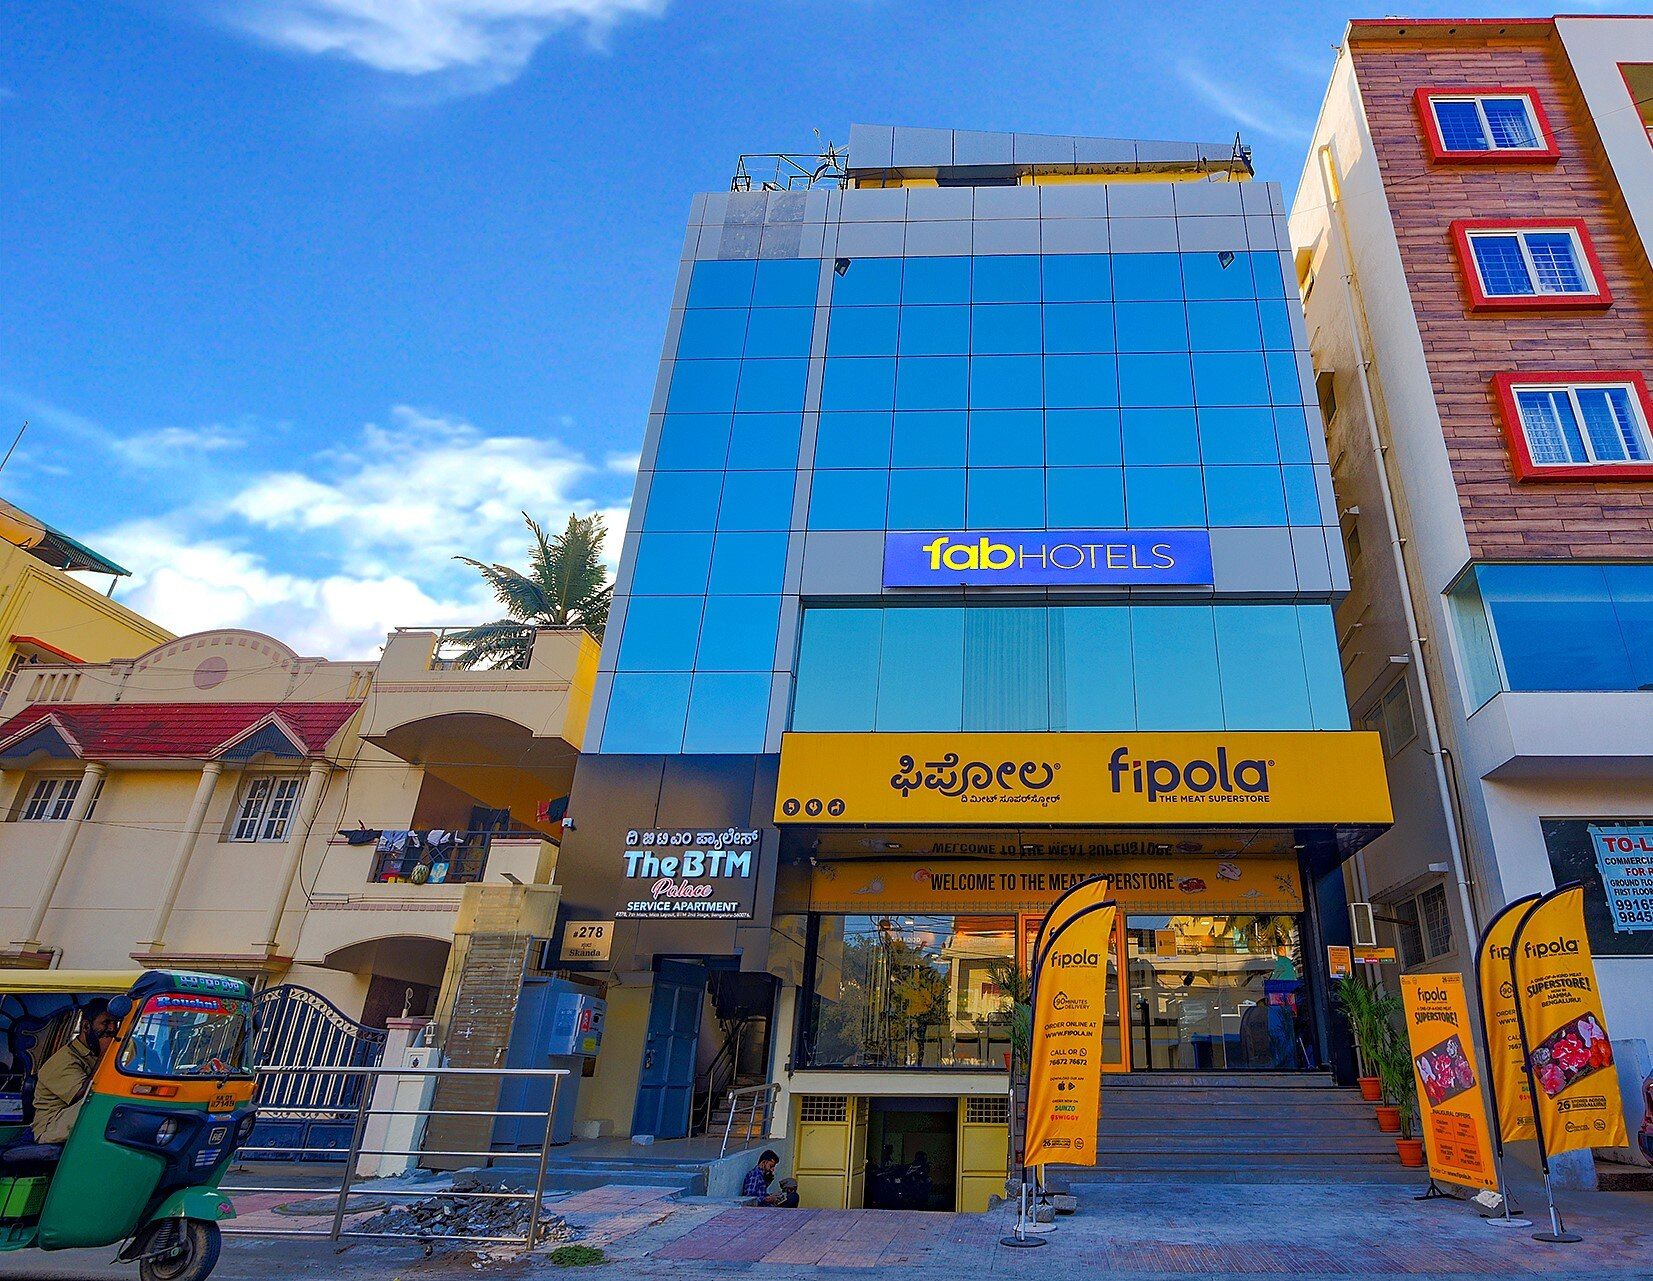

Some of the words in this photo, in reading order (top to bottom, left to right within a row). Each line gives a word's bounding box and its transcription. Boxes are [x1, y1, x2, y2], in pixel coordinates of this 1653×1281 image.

[1108, 746, 1269, 802] fipola
[1208, 795, 1270, 803] SUPERSTORE
[1602, 837, 1653, 852] TO-L
[623, 850, 679, 878] The
[682, 850, 752, 878] BTM
[1626, 868, 1646, 876] FOR
[930, 873, 995, 890] WELCOME
[999, 873, 1016, 890] TO
[1019, 873, 1045, 890] THE
[1089, 872, 1174, 890] PERSTORE
[1610, 879, 1640, 887] GROUND
[651, 878, 712, 900] Palace
[1614, 888, 1631, 896] FIRST
[626, 902, 671, 911] SERVICE
[672, 902, 738, 911] APARTMENT
[1618, 911, 1653, 922] 9845
[573, 926, 604, 938] #278
[1524, 937, 1578, 958] fipola
[1051, 949, 1099, 969] fipola
[1526, 976, 1592, 998] SUPERSTORE!
[1417, 987, 1447, 1004] fipola
[1044, 1021, 1065, 1030] ORDER
[1414, 1011, 1459, 1028] SUPERSTORE!
[1557, 1100, 1571, 1111] 26
